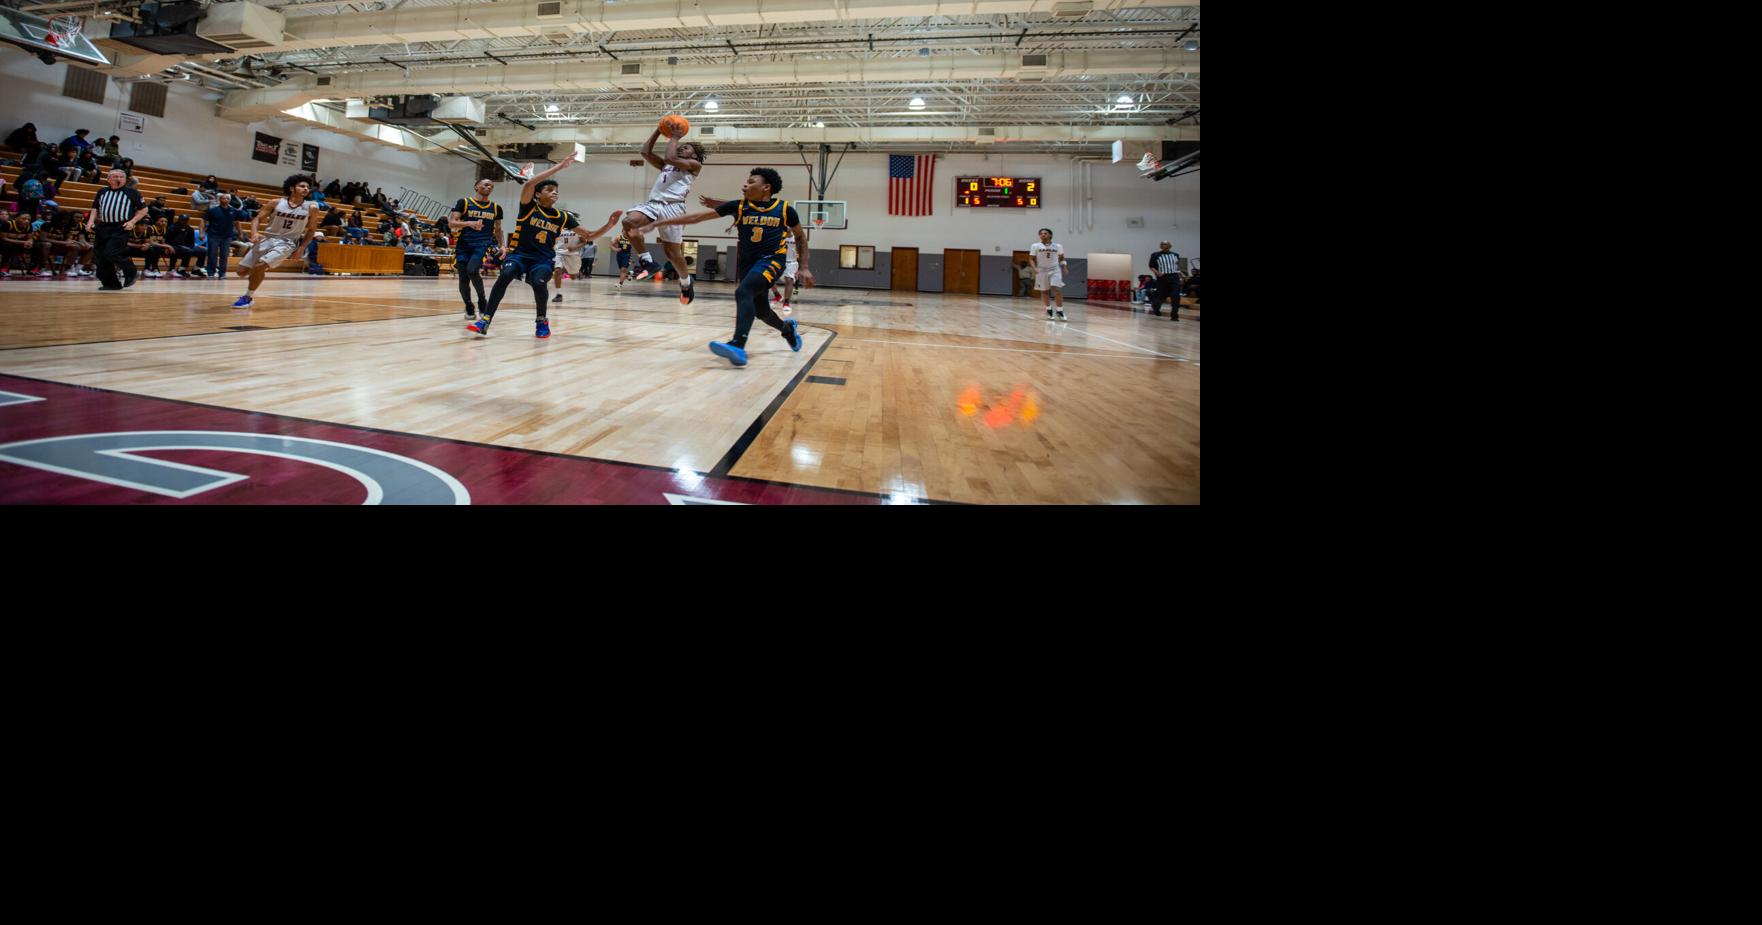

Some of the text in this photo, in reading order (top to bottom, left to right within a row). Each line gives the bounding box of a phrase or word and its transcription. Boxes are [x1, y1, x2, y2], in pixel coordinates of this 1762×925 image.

[970, 182, 978, 191] 0
[991, 177, 1013, 187] 7:06
[1027, 182, 1035, 191] 2
[1004, 187, 1009, 195] 1
[1030, 198, 1037, 206] 0
[467, 210, 495, 220] WELDON
[282, 219, 294, 230] 12
[742, 215, 780, 228] WELDON
[535, 230, 548, 244] 4
[750, 226, 764, 243] 3
